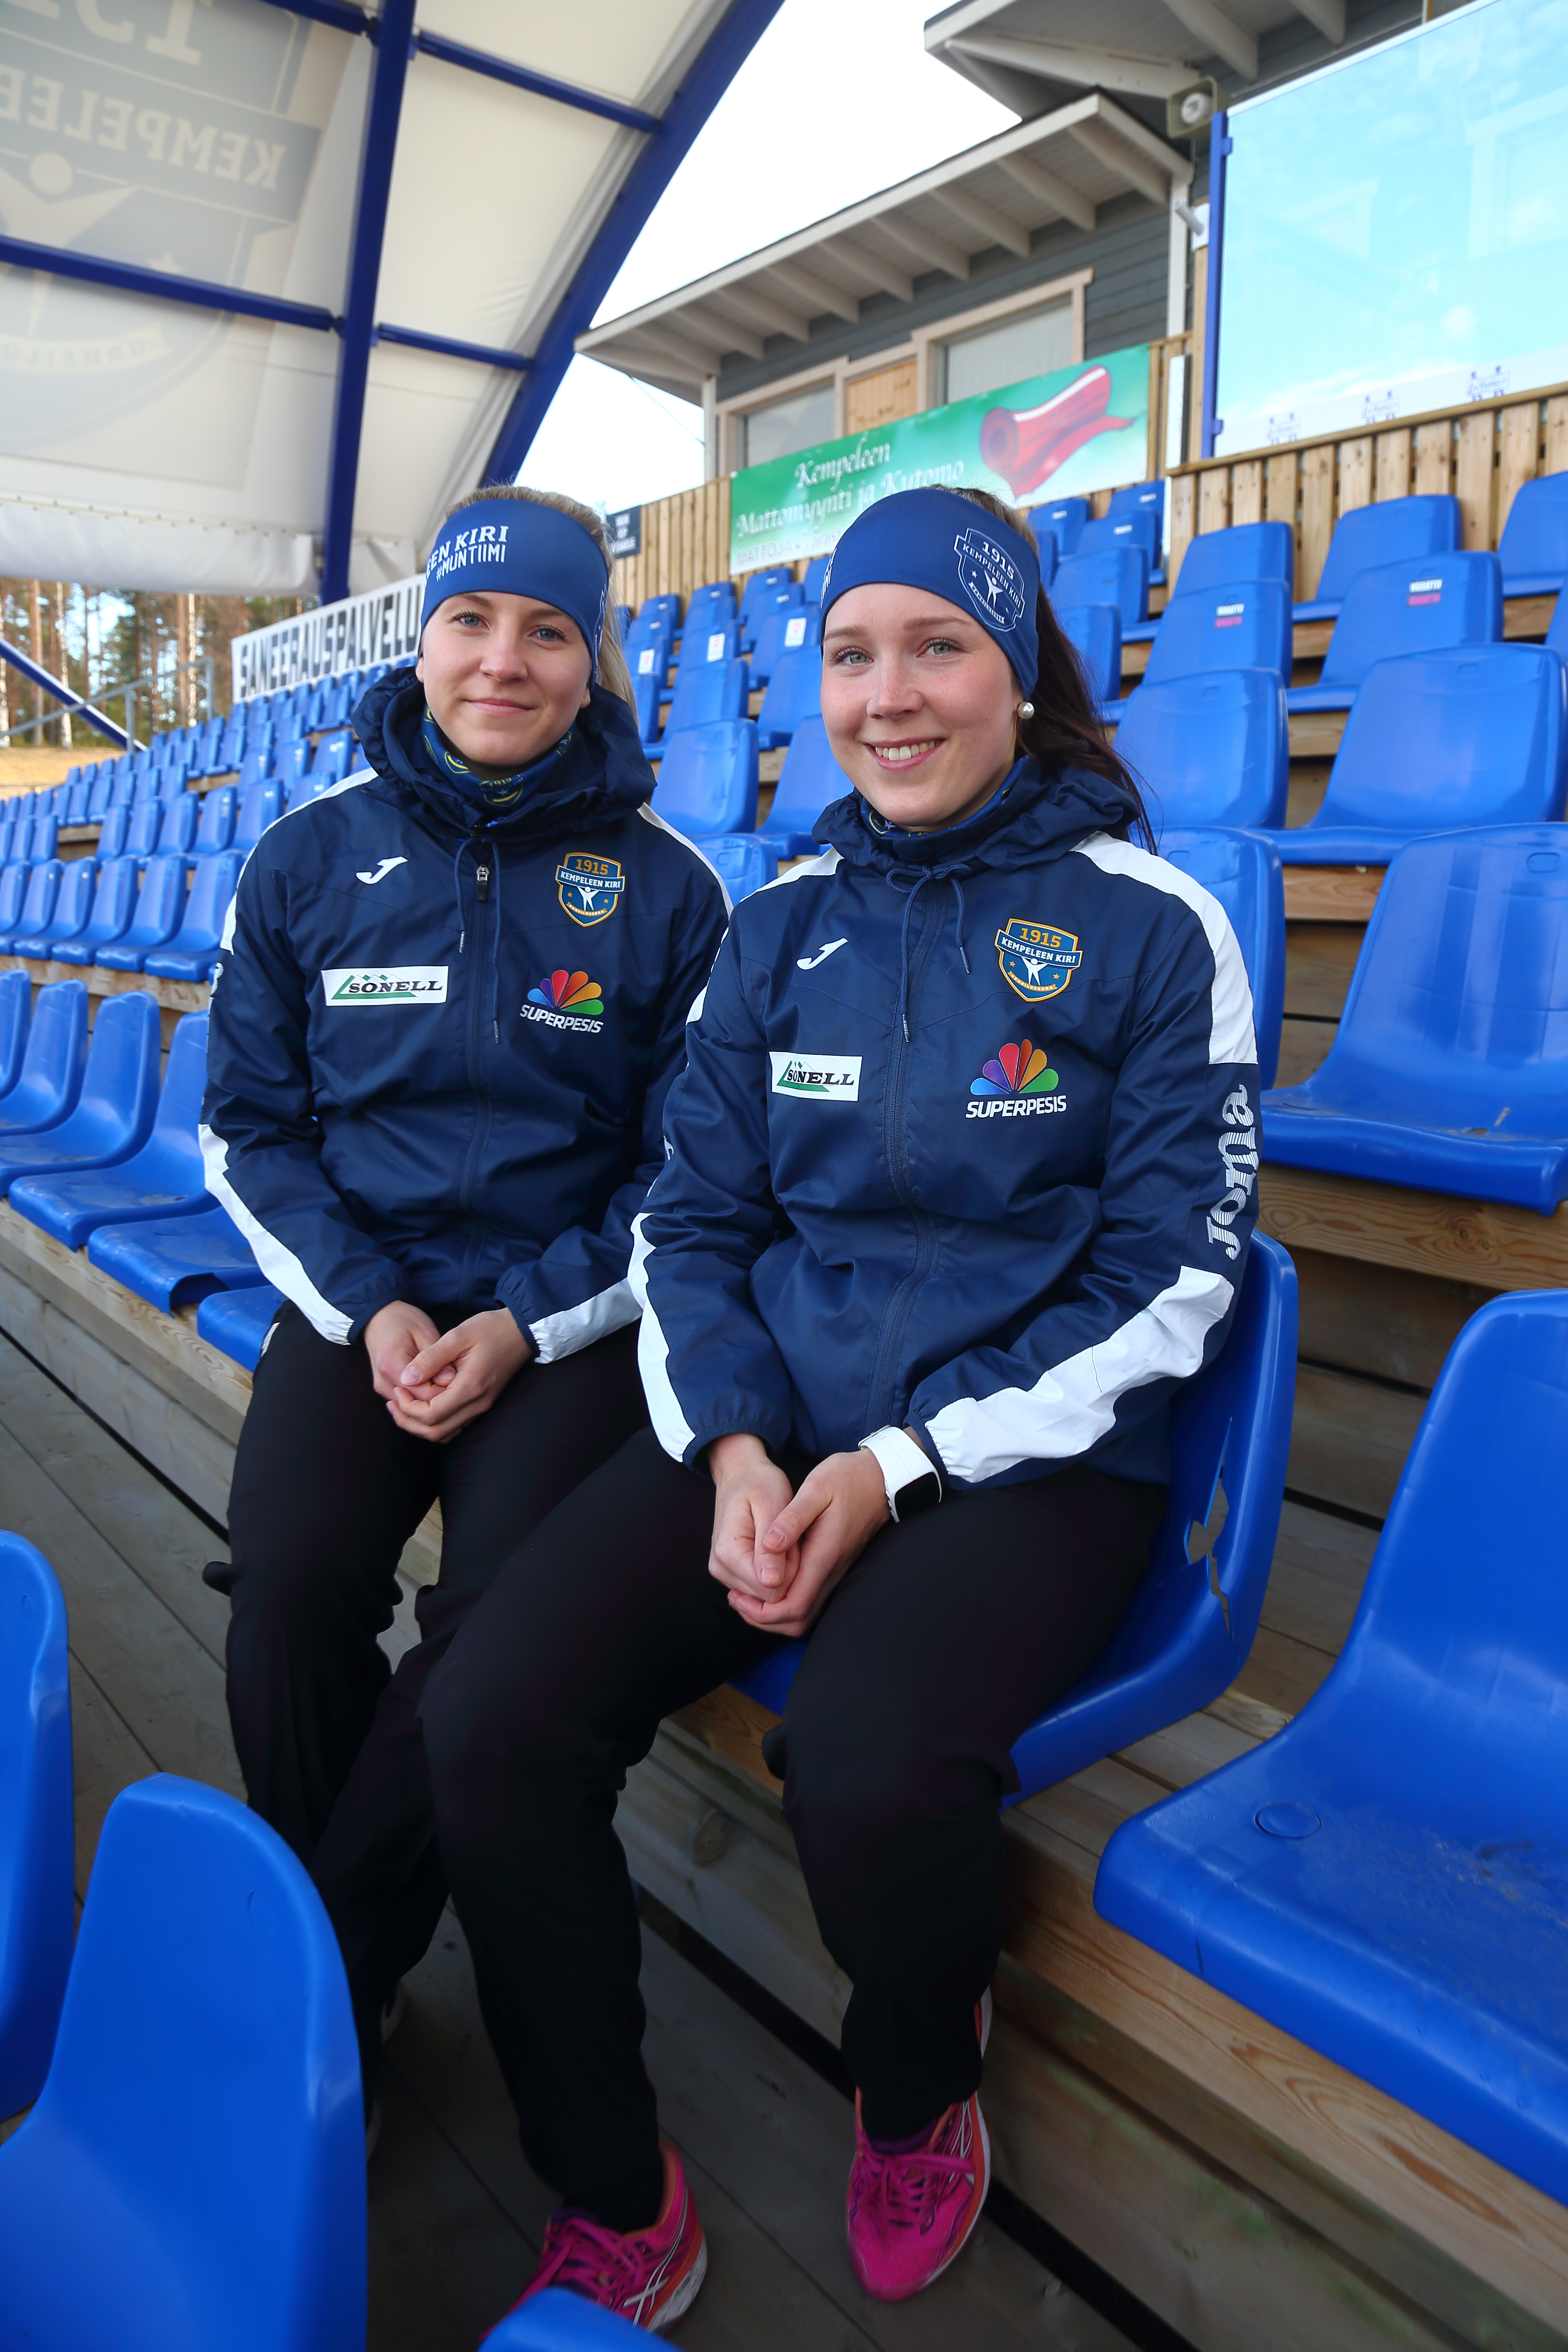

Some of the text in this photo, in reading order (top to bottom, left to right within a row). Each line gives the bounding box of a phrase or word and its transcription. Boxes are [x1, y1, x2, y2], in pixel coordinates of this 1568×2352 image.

[794, 431, 891, 492] Kempeleen
[736, 460, 964, 539] Mattomyynti ja Kutomo
[425, 525, 509, 584] EEN KIRI
[436, 543, 506, 582] #MUNTIIMI
[982, 541, 1015, 580] 1915
[962, 543, 1009, 590] KEMPELEEN
[1009, 588, 1021, 609] KIRI
[560, 871, 603, 887] KEMPELEEN
[575, 859, 609, 875] 1915
[1001, 937, 1076, 964] KEMPELEEN KIRI
[1020, 927, 1062, 948] 1915
[348, 980, 444, 993] SONELL
[1011, 974, 1054, 991] URHEILUSEURA
[520, 1004, 604, 1033] SUPERPESIS
[786, 1069, 855, 1086] SONELL
[965, 1095, 1067, 1118] SUPERPESIS
[1206, 1084, 1259, 1261] Joma
